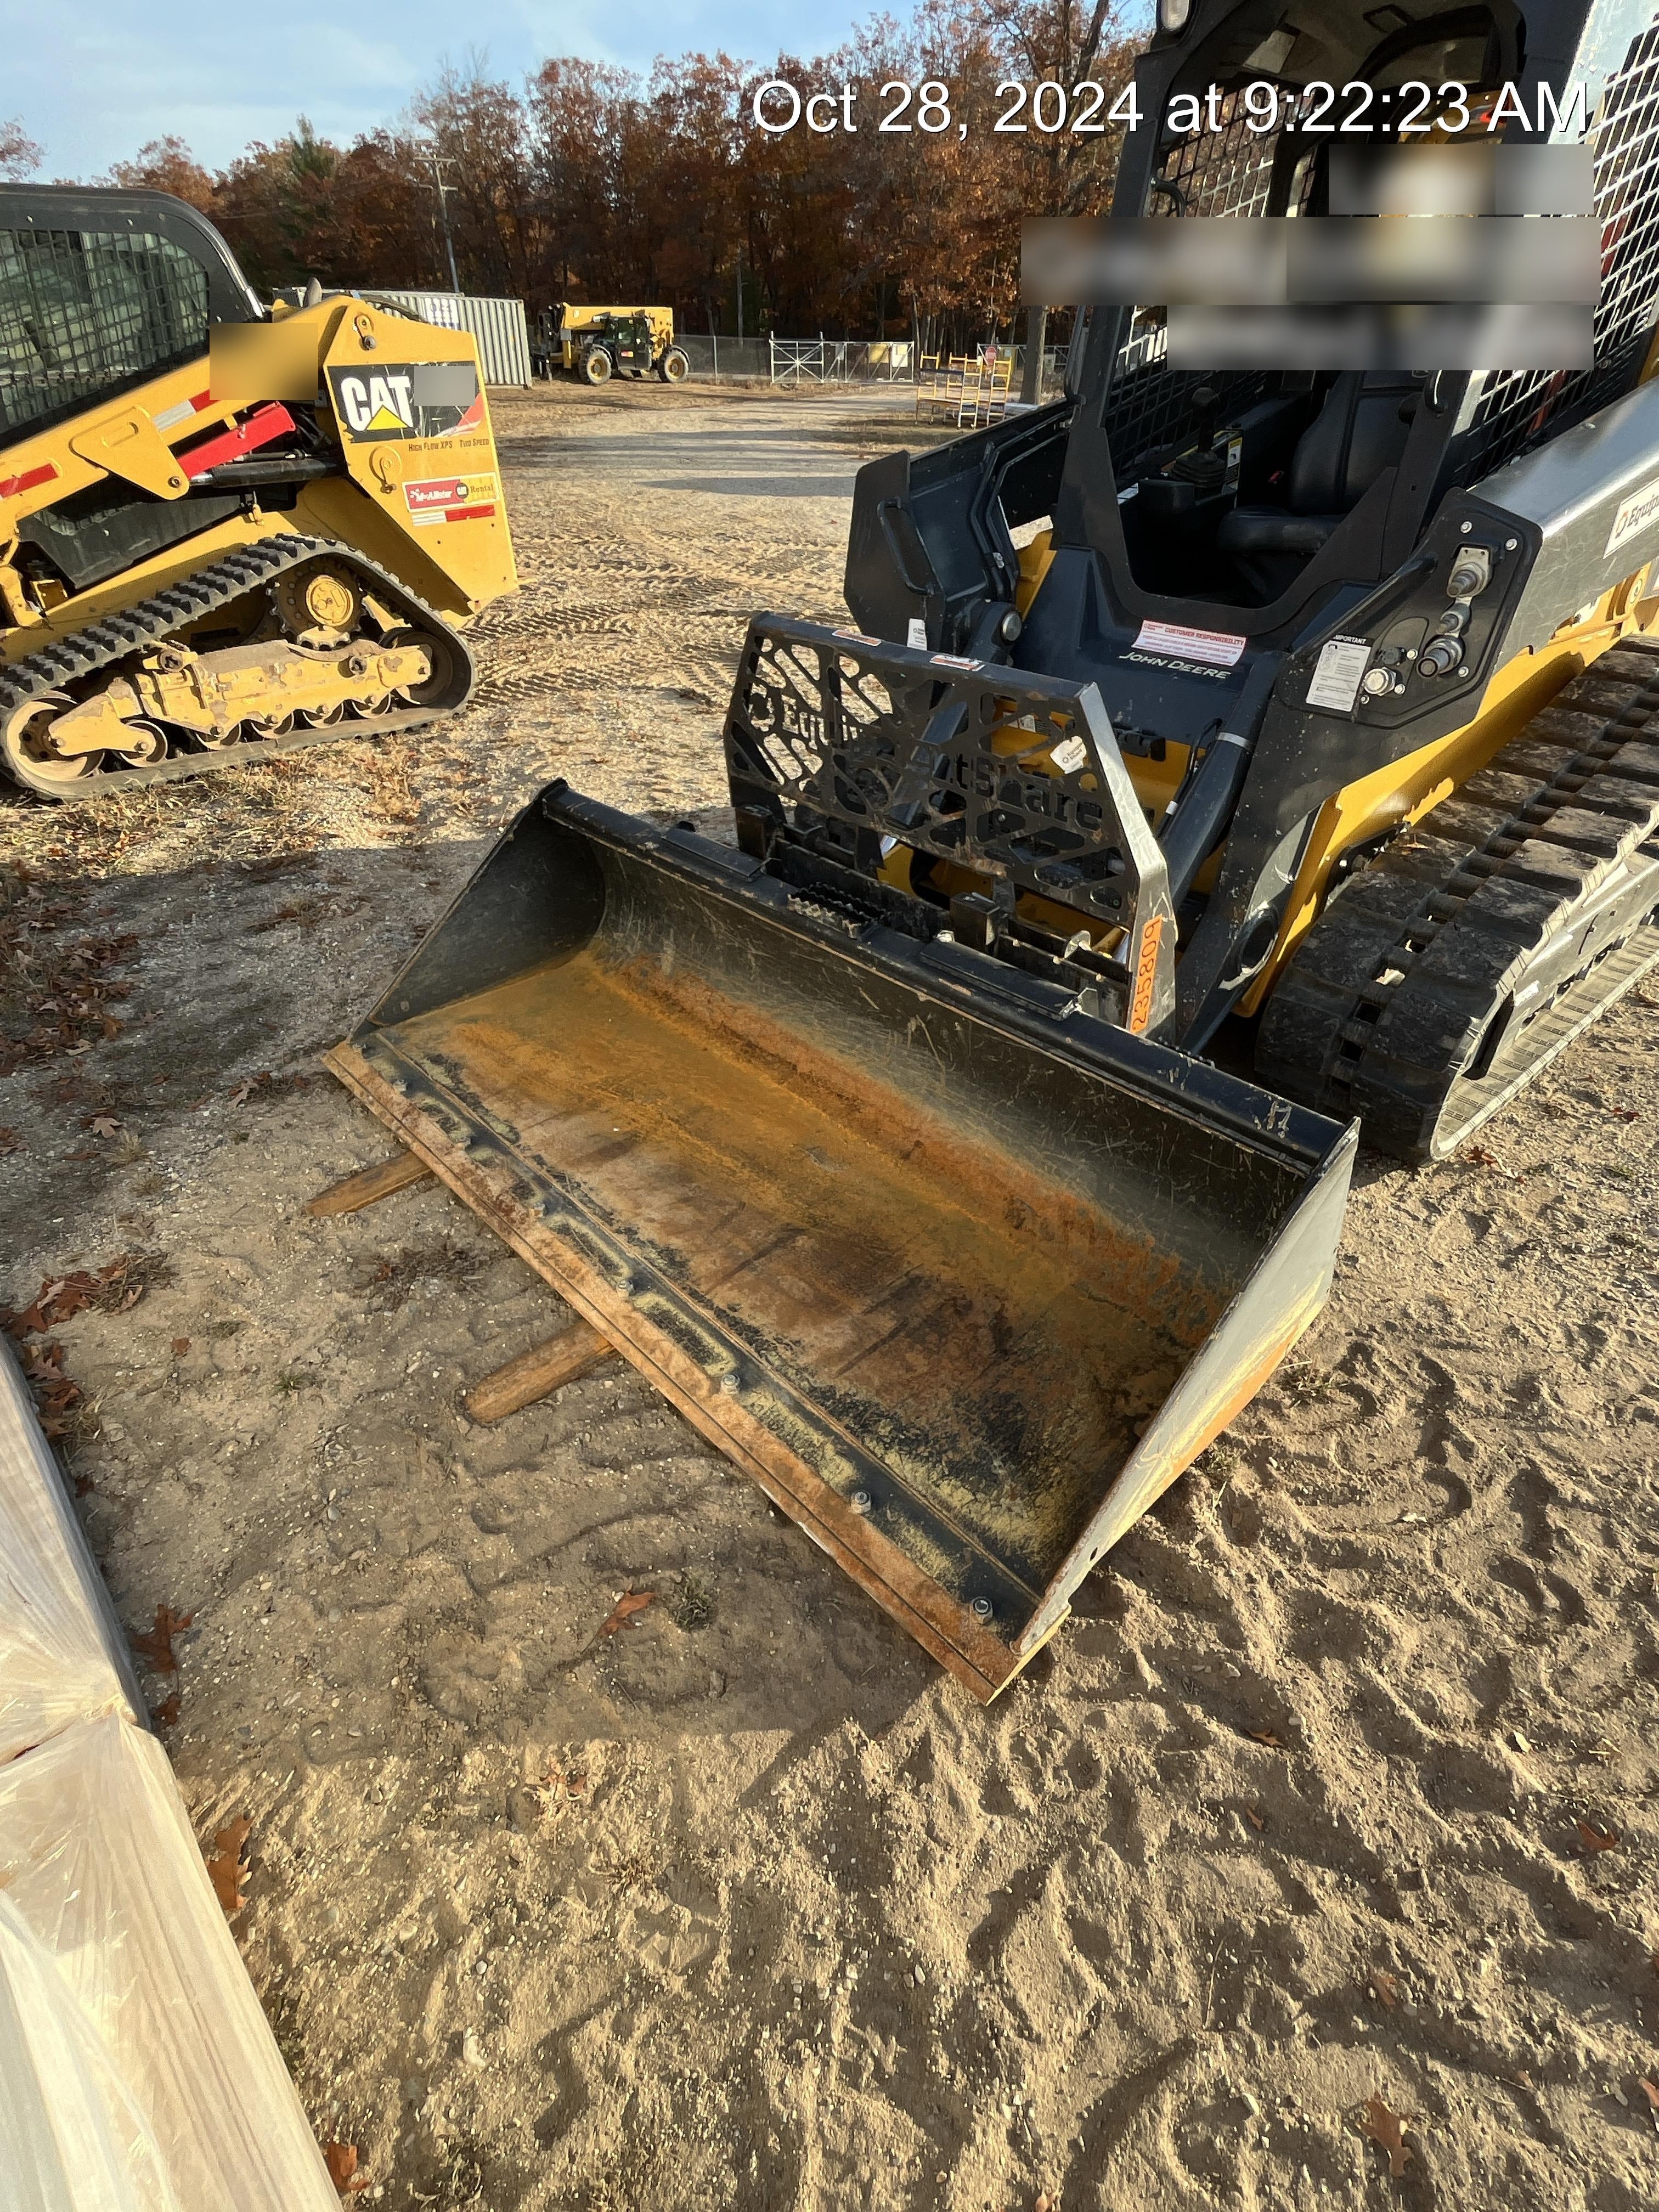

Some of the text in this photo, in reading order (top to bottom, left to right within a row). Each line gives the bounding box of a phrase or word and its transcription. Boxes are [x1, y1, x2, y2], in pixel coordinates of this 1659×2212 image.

[340, 376, 414, 432] CAT
[440, 441, 453, 449] XPS
[470, 483, 494, 493] Rental
[1165, 627, 1245, 646] CUSTOMER RESPONSIBILITY
[1119, 652, 1232, 679] JOHN DEERE
[781, 693, 1103, 831] EquitShare
[1132, 918, 1160, 1030] 235809
